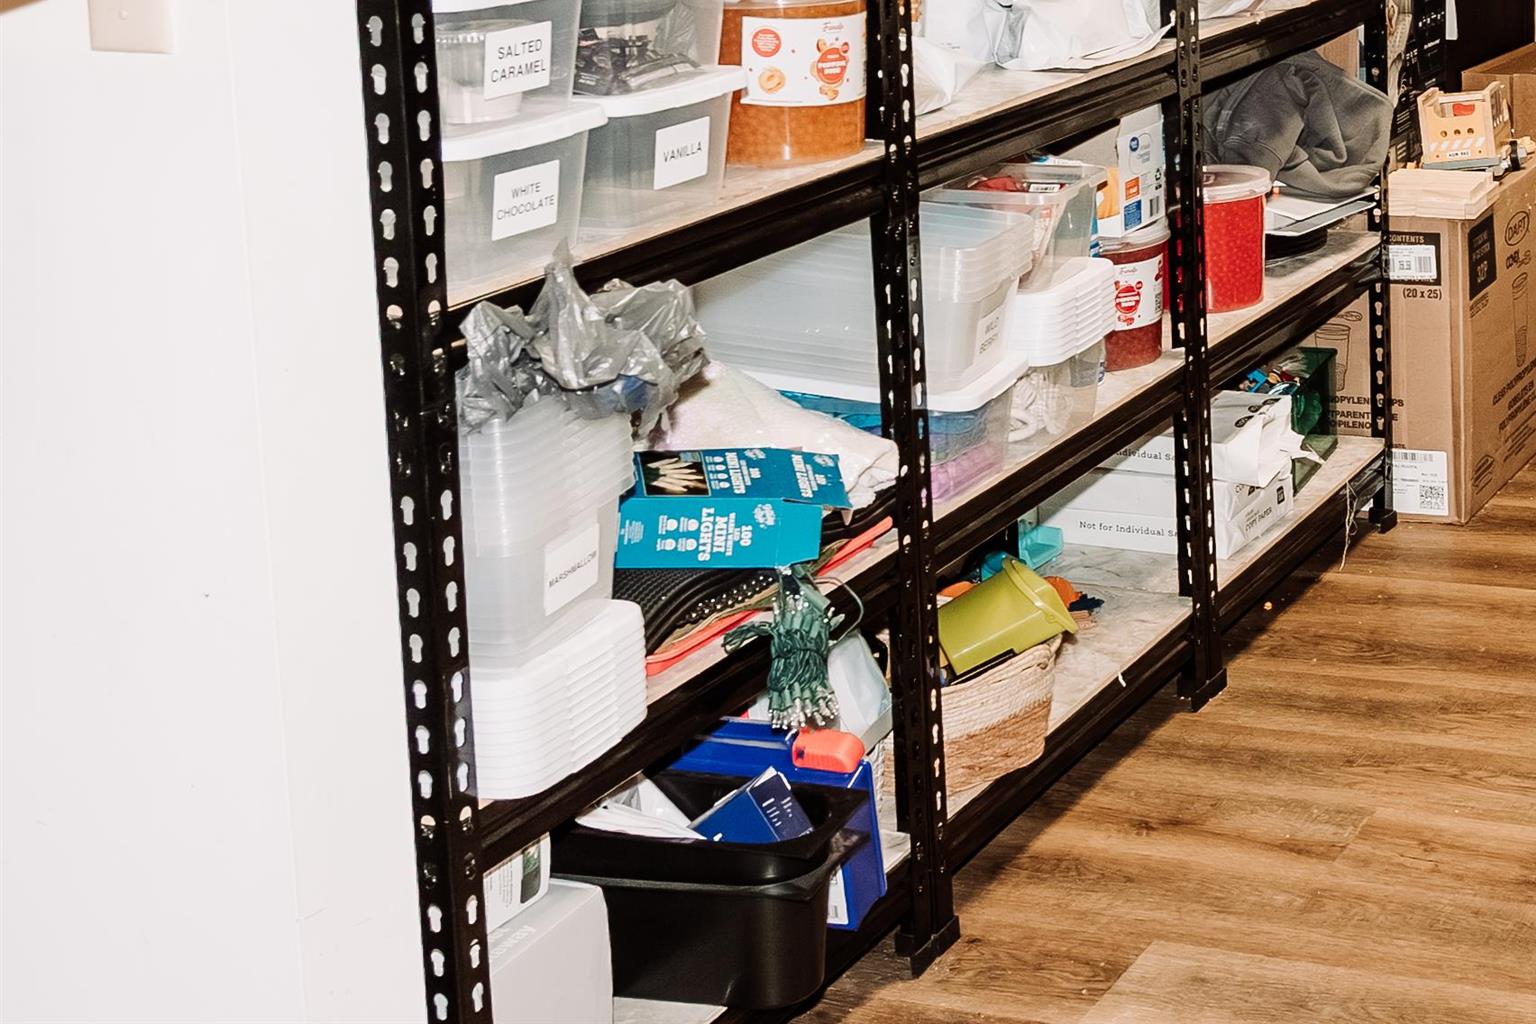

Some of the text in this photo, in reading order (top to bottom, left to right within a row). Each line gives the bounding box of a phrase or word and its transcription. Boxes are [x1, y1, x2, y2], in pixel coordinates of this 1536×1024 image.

[497, 38, 543, 60] SALTED
[490, 59, 547, 83] CARAMEL
[663, 141, 702, 162] VANILLA
[511, 181, 541, 198] WHITE
[496, 194, 555, 221] CHOCOLATE
[1508, 215, 1527, 242] DART
[1402, 287, 1418, 299] (20
[1427, 289, 1442, 301] 25)
[1080, 521, 1165, 537] Not for Individual
[1245, 506, 1273, 532] COPY PAPER
[698, 507, 715, 561] LIGHTS
[713, 516, 728, 552] MINI
[740, 525, 752, 546] 100
[548, 549, 597, 588] MARSHMALLOW
